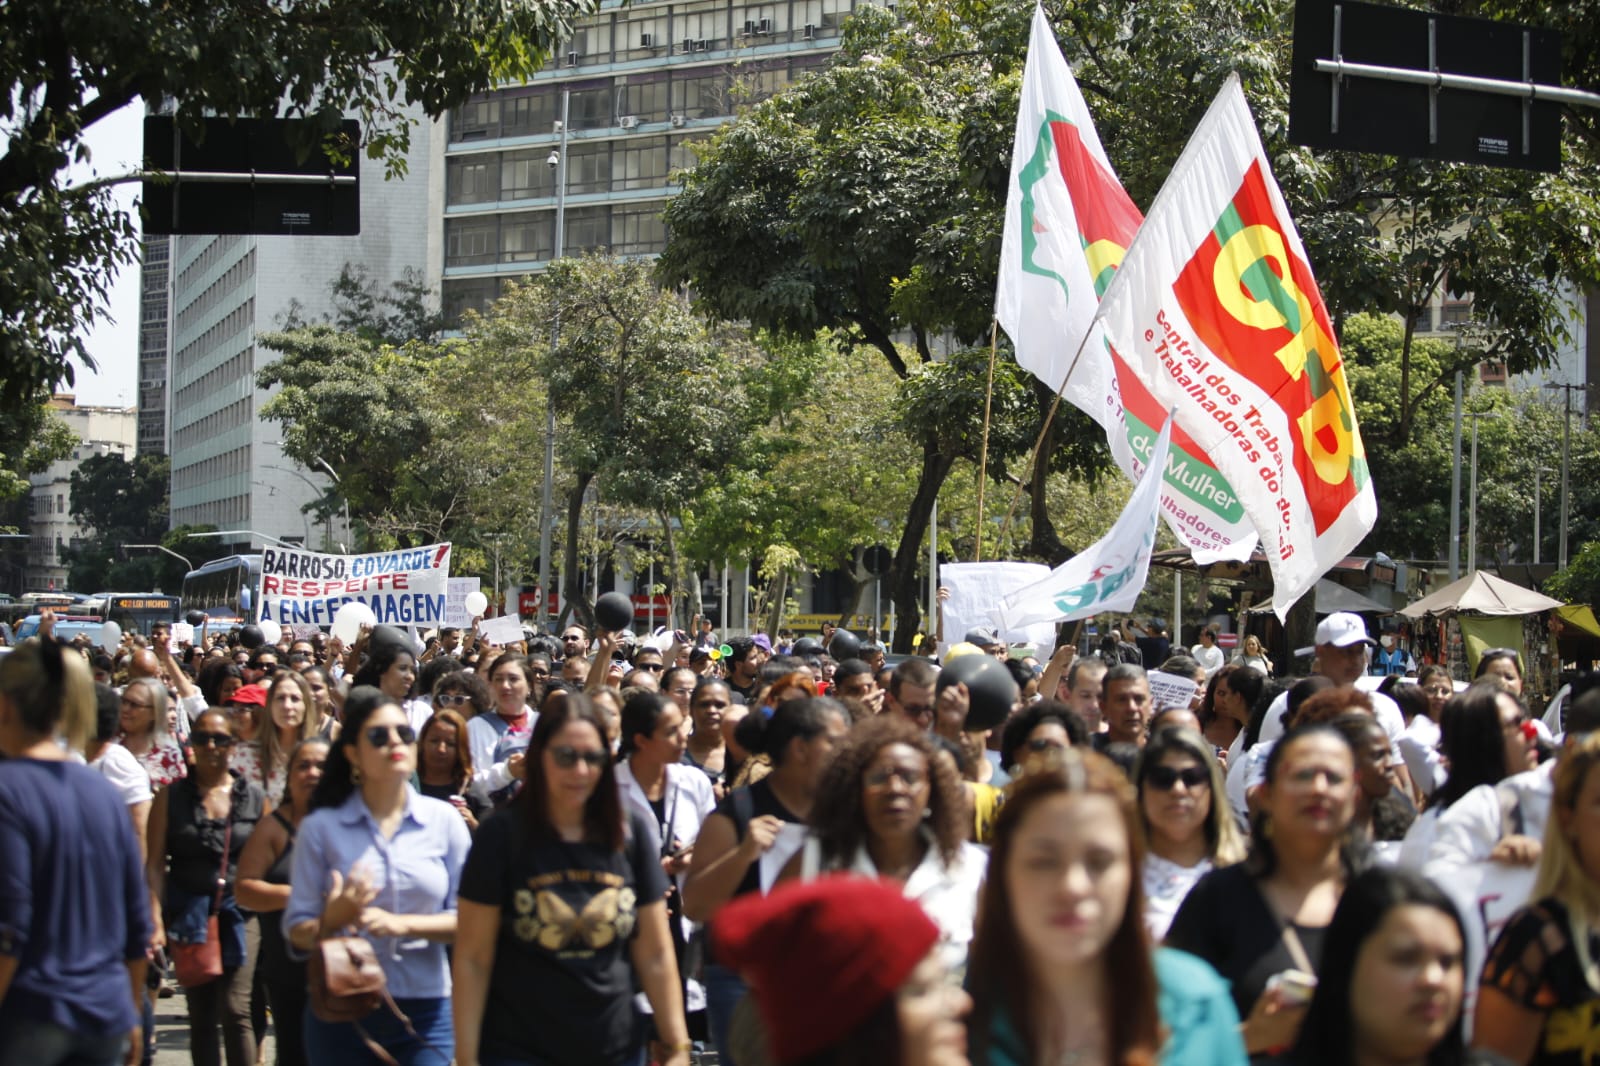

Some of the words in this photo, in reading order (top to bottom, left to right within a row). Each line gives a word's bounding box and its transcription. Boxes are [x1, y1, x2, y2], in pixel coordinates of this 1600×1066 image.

[1156, 309, 1209, 374] Central
[1205, 373, 1242, 406] dos
[1144, 329, 1154, 341] e
[1154, 339, 1261, 463] Trabalhadoras
[1259, 466, 1279, 493] do
[1166, 453, 1237, 510] Mulher
[1160, 494, 1232, 546] lhadores
[262, 549, 349, 582] BARROSO,
[352, 545, 450, 578] COVARDE!
[262, 573, 409, 597] RESPEITE
[260, 600, 273, 622] A
[279, 593, 446, 625] ENFEMAGEM
